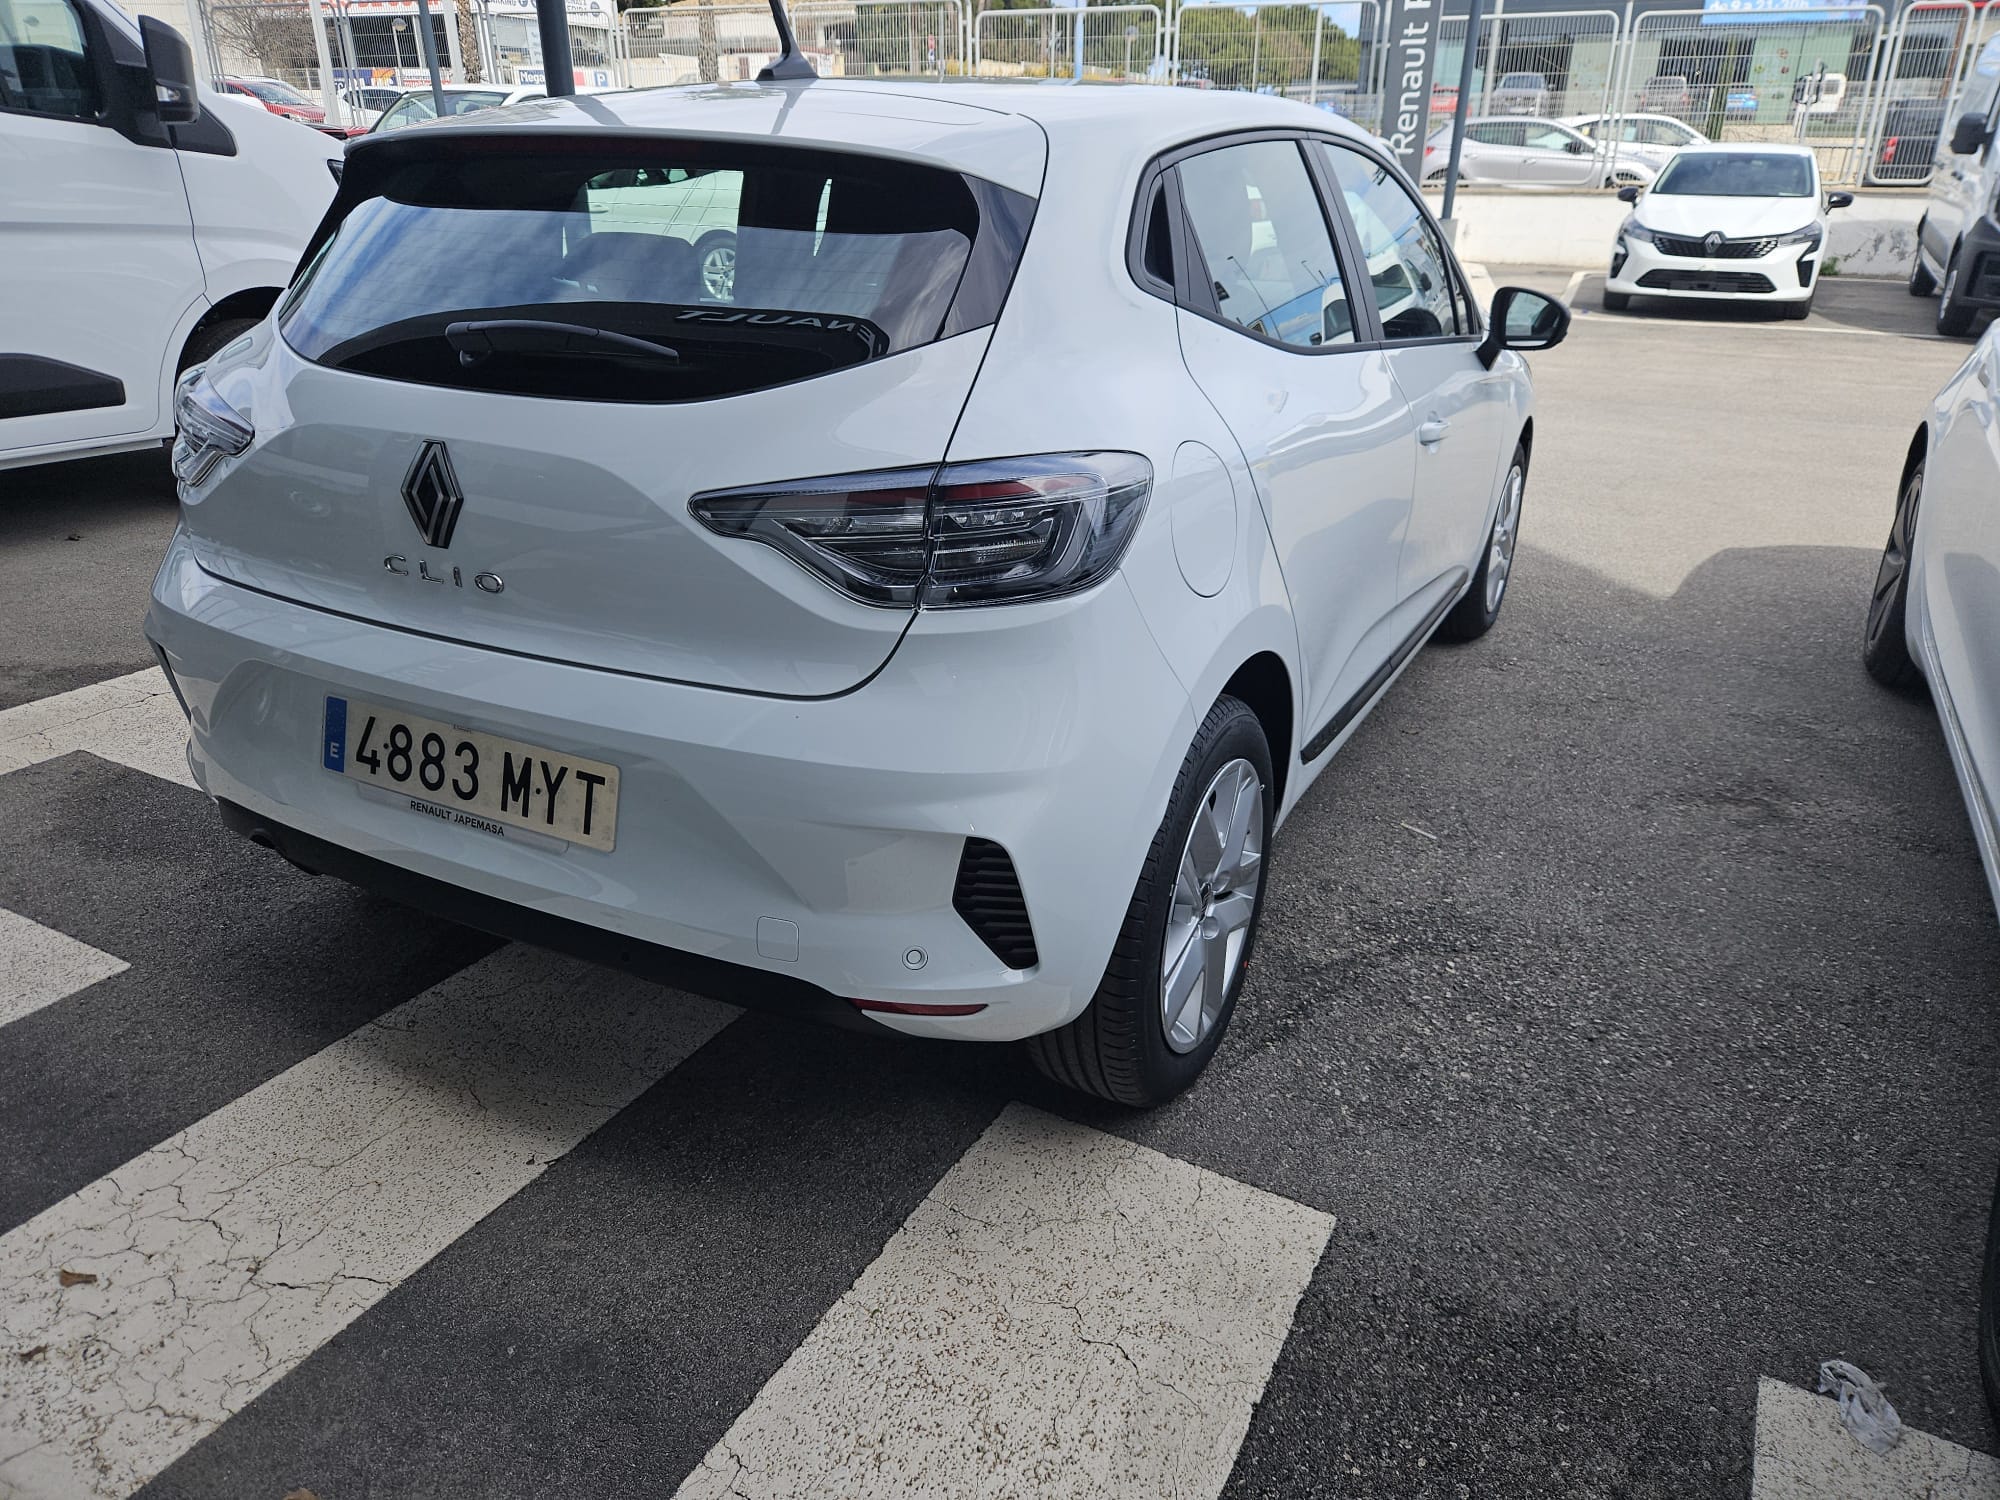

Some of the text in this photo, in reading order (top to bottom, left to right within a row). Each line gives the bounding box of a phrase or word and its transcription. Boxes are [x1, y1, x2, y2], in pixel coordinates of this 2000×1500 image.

[1390, 21, 1429, 155] Renault
[384, 554, 504, 593] CLIO
[329, 742, 339, 758] E
[355, 716, 606, 835] 4883 MYT
[410, 800, 504, 836] RENAULT JAPEMASA
